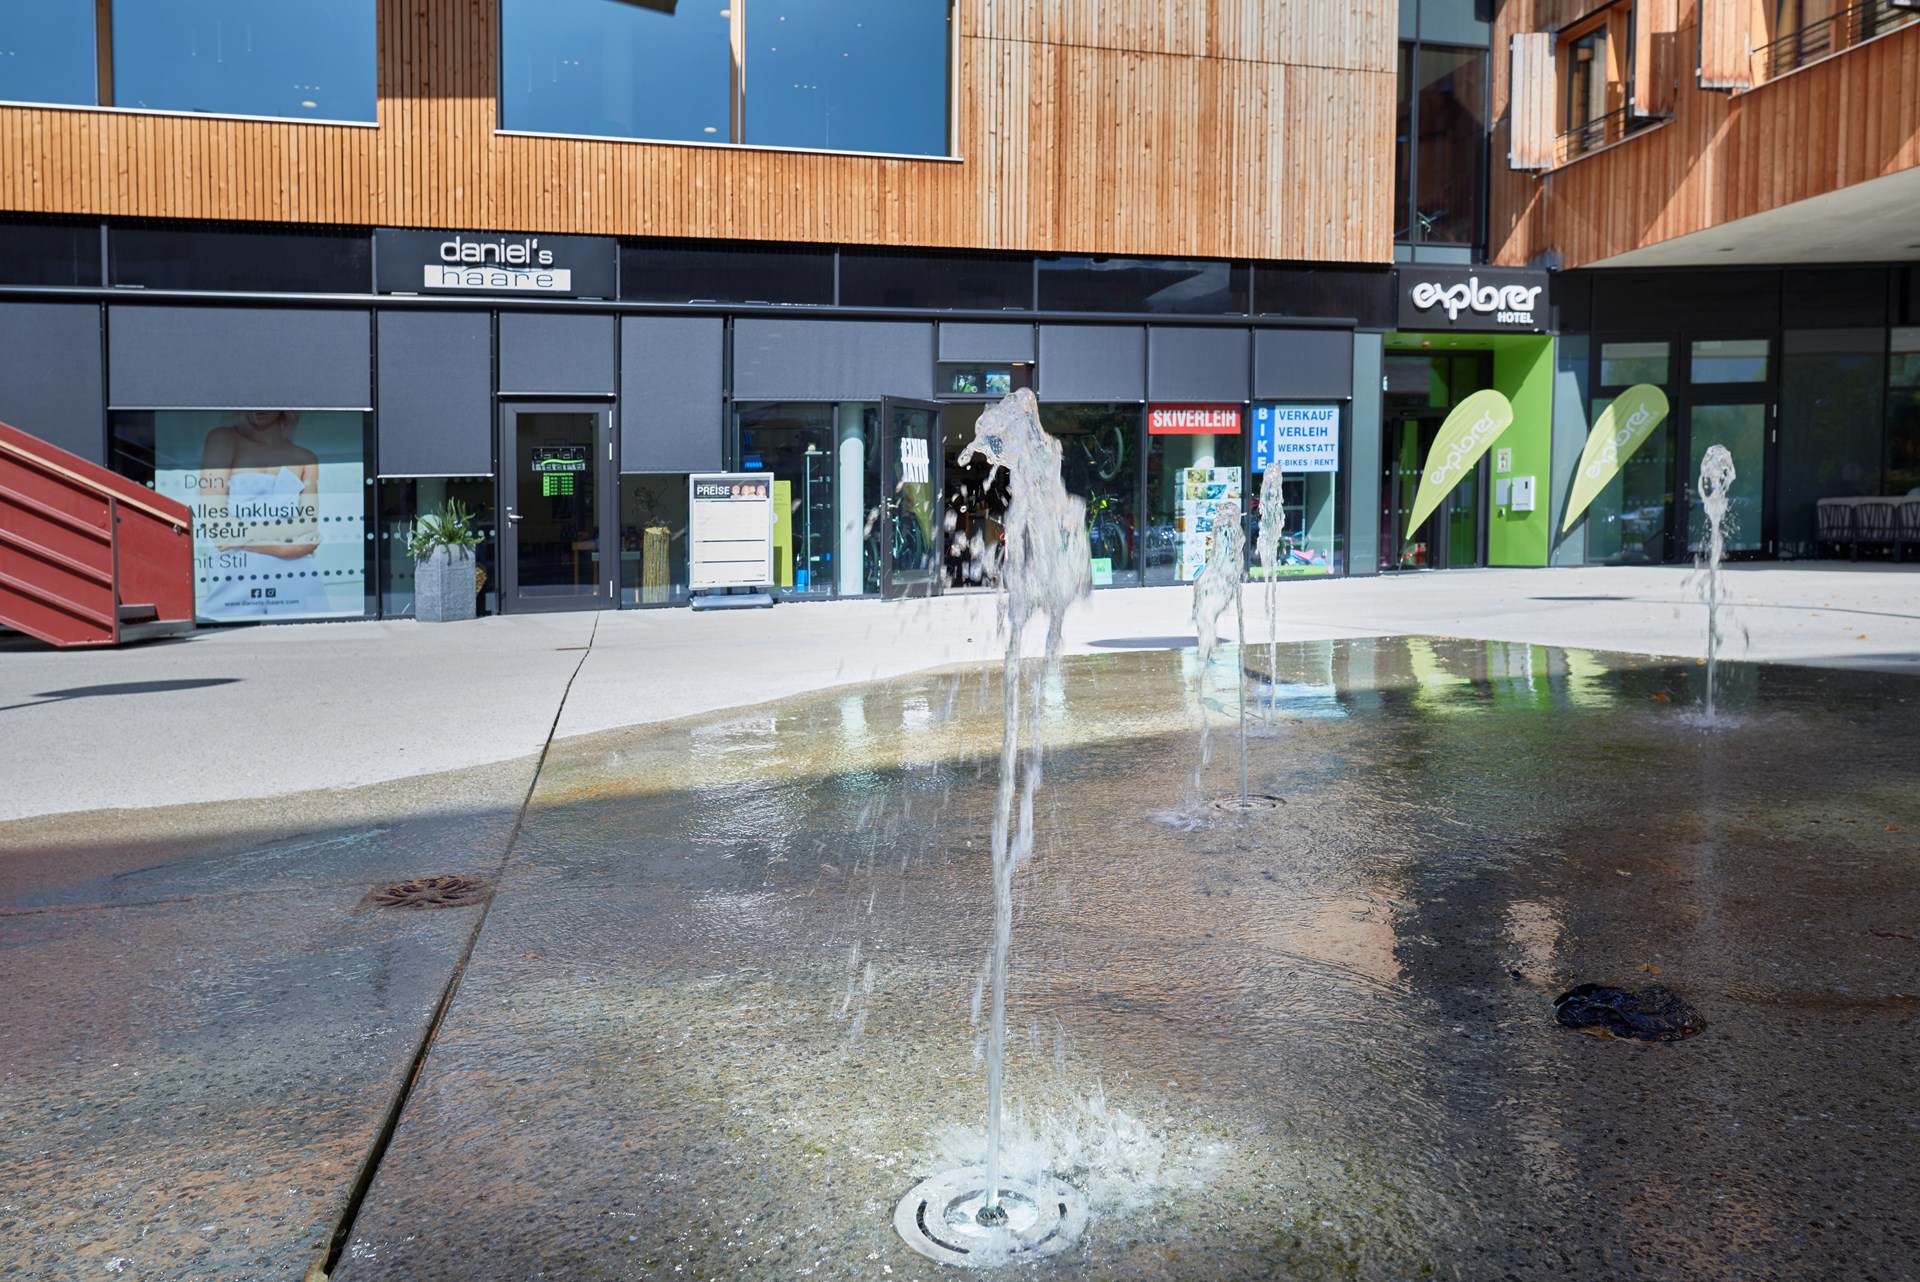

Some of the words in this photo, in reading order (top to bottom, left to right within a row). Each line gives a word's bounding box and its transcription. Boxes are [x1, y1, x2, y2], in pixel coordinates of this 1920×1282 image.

[440, 236, 553, 265] daniel's
[441, 265, 553, 288] haare
[1412, 276, 1542, 320] explorer
[1497, 311, 1534, 323] HOTEL
[1153, 409, 1236, 428] SKIVERLEIH
[1278, 410, 1333, 421] VERKAUF
[1257, 407, 1268, 470] BIKE
[1278, 427, 1328, 437] VERLEIH
[1585, 402, 1649, 478] explorer
[1278, 443, 1335, 453] WERKSTATT
[1430, 410, 1494, 485] explorer
[1278, 458, 1308, 467] E-BIKES
[1314, 458, 1335, 467] RENT
[696, 486, 730, 496] PREISE
[235, 502, 315, 518] Inklusive
[193, 524, 248, 539] riseur
[219, 553, 247, 569] Stil
